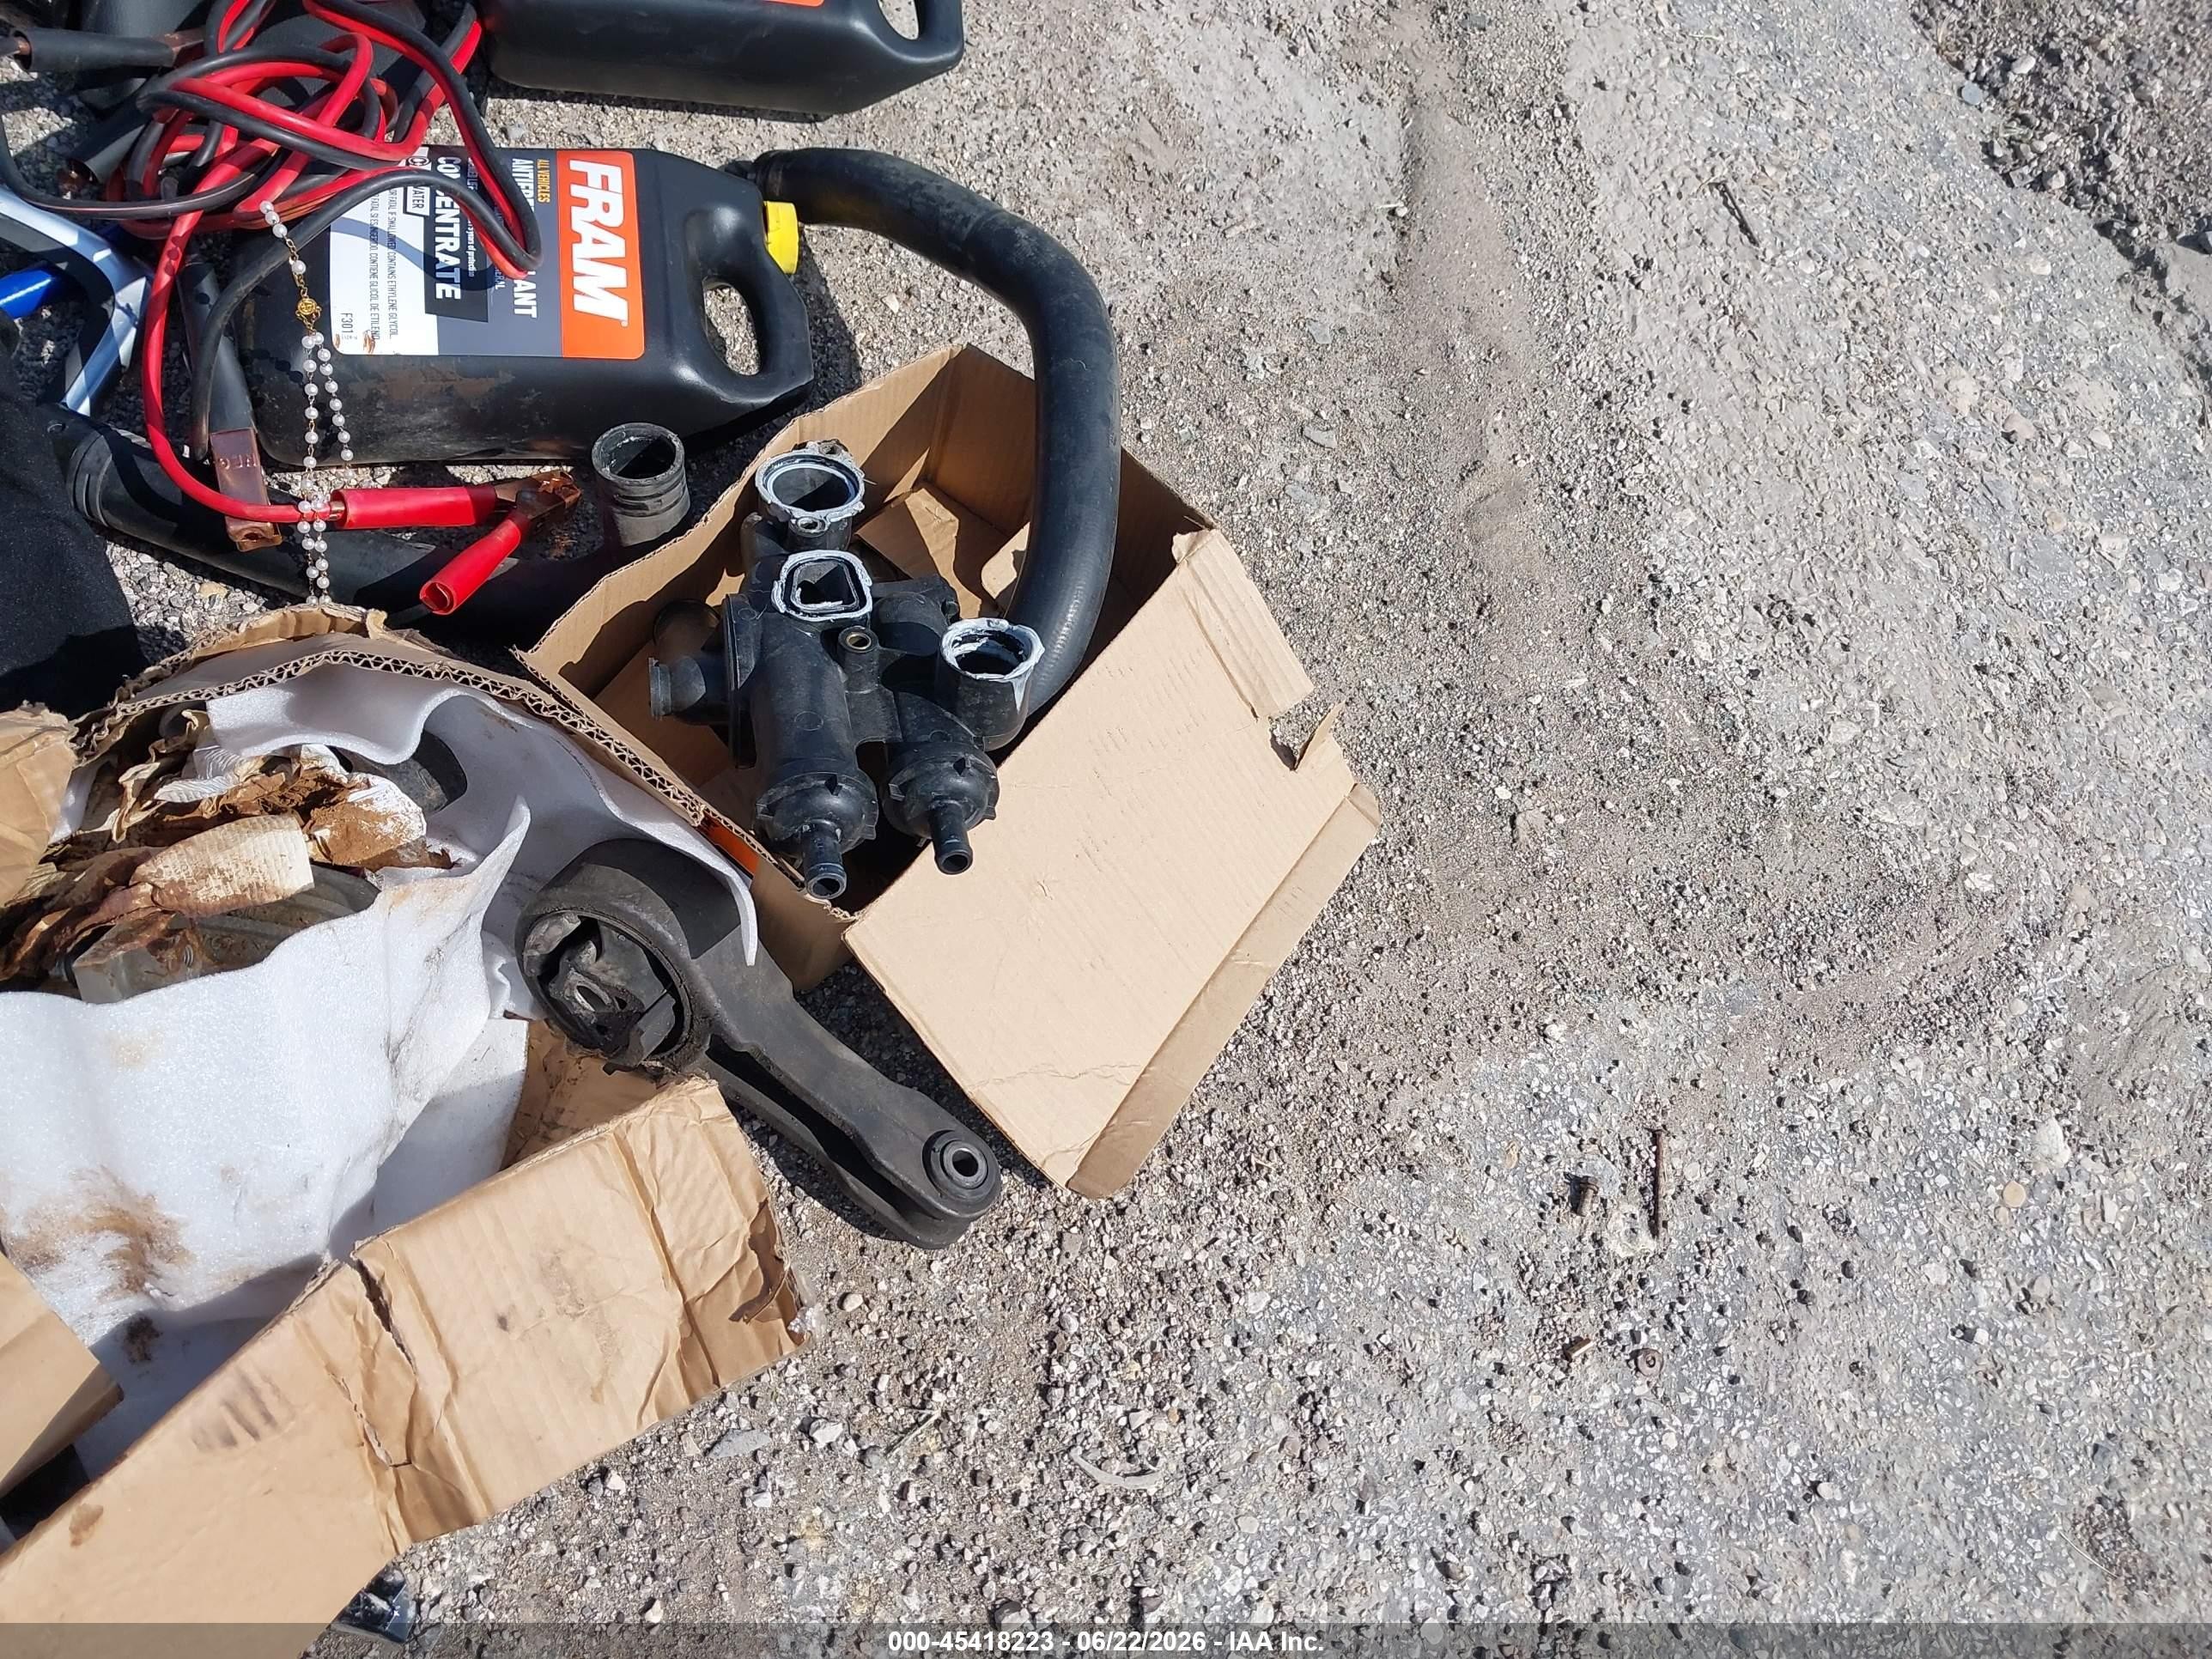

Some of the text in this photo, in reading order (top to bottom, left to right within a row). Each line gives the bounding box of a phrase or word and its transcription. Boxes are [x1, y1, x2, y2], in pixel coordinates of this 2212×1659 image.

[538, 158, 550, 204] ALL VEHICLES
[370, 198, 380, 212] FATAL
[387, 197, 398, 210] FATAL
[568, 160, 629, 322] FRAM
[369, 252, 379, 281] CONTIENE
[386, 252, 397, 280] CONTAINS
[465, 251, 477, 277] protection
[369, 281, 379, 302] GLICOL
[387, 280, 398, 312] ETHYLENE
[369, 303, 380, 312] DE
[340, 313, 354, 333] F301
